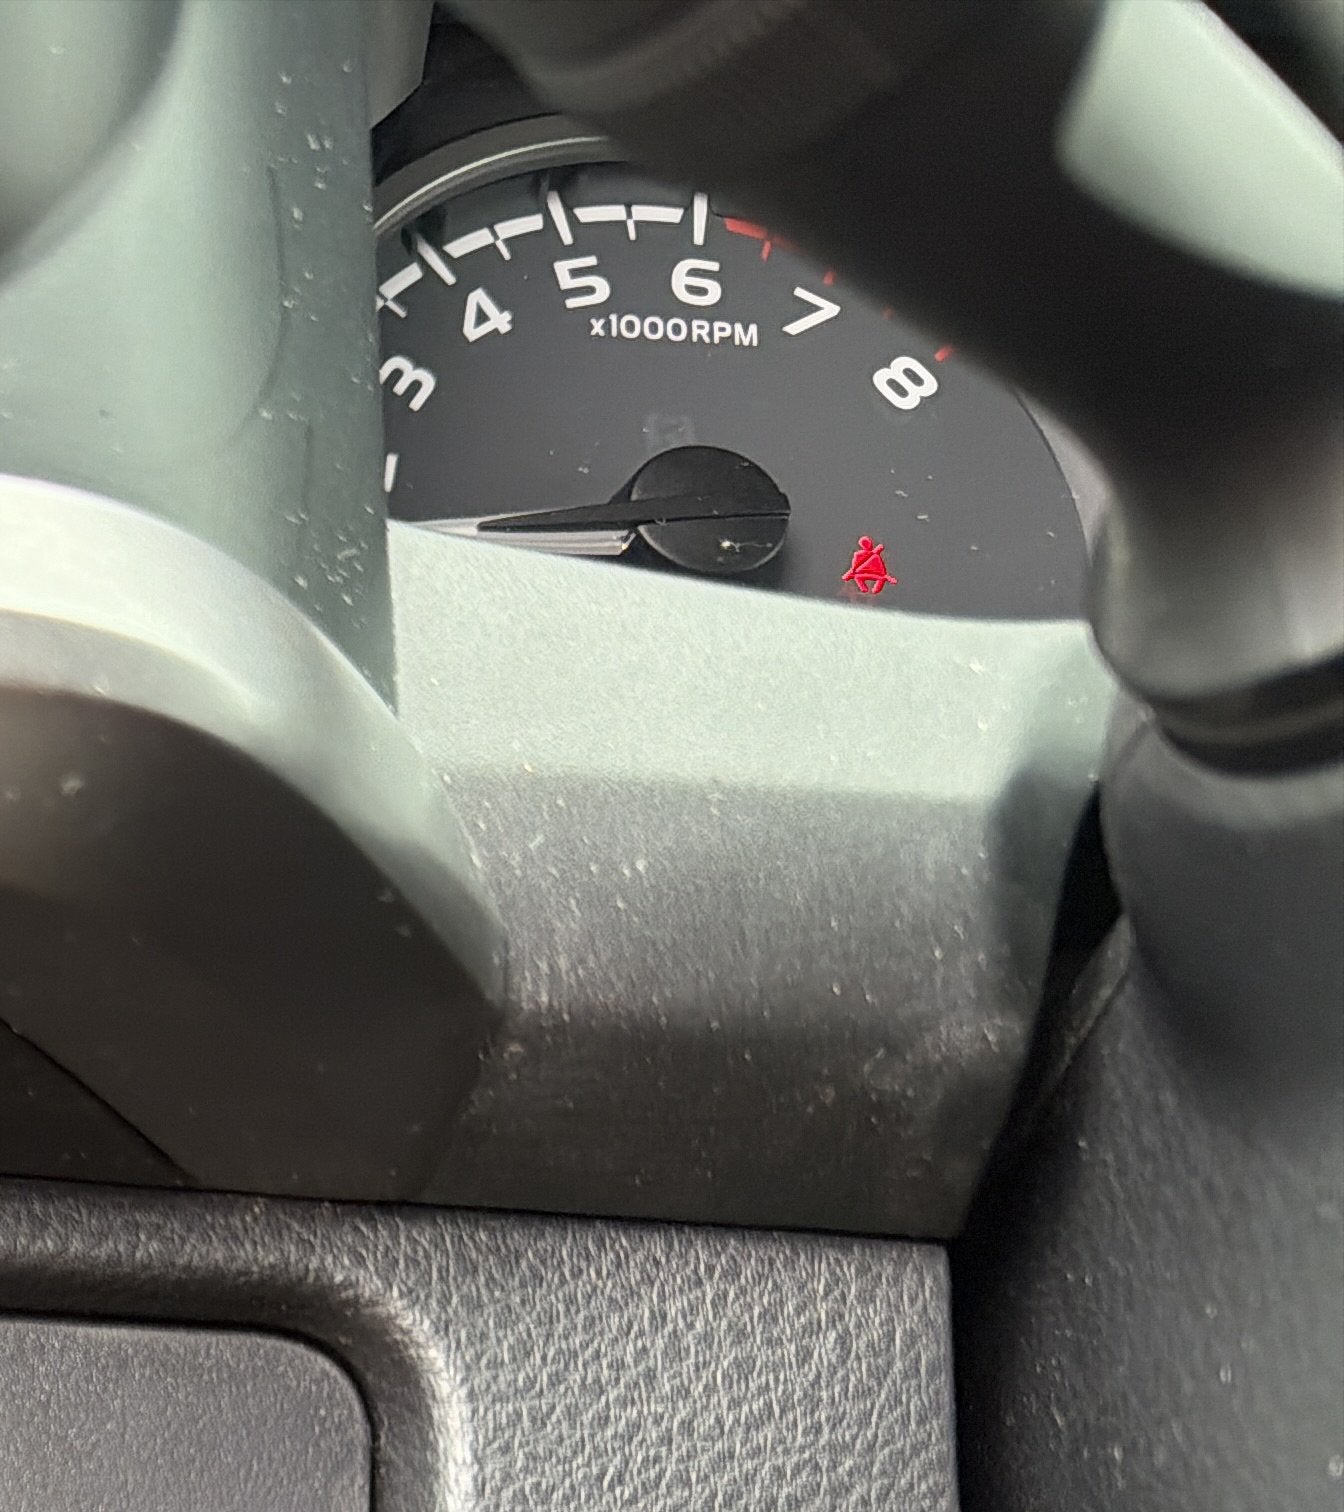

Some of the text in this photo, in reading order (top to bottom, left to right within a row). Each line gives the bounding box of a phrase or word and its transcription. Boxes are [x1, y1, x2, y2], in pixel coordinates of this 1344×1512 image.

[554, 256, 610, 308] 5
[672, 259, 721, 306] 6
[463, 288, 512, 342] 4
[782, 287, 841, 336] 7
[379, 355, 436, 412] 3
[872, 356, 939, 410] 8
